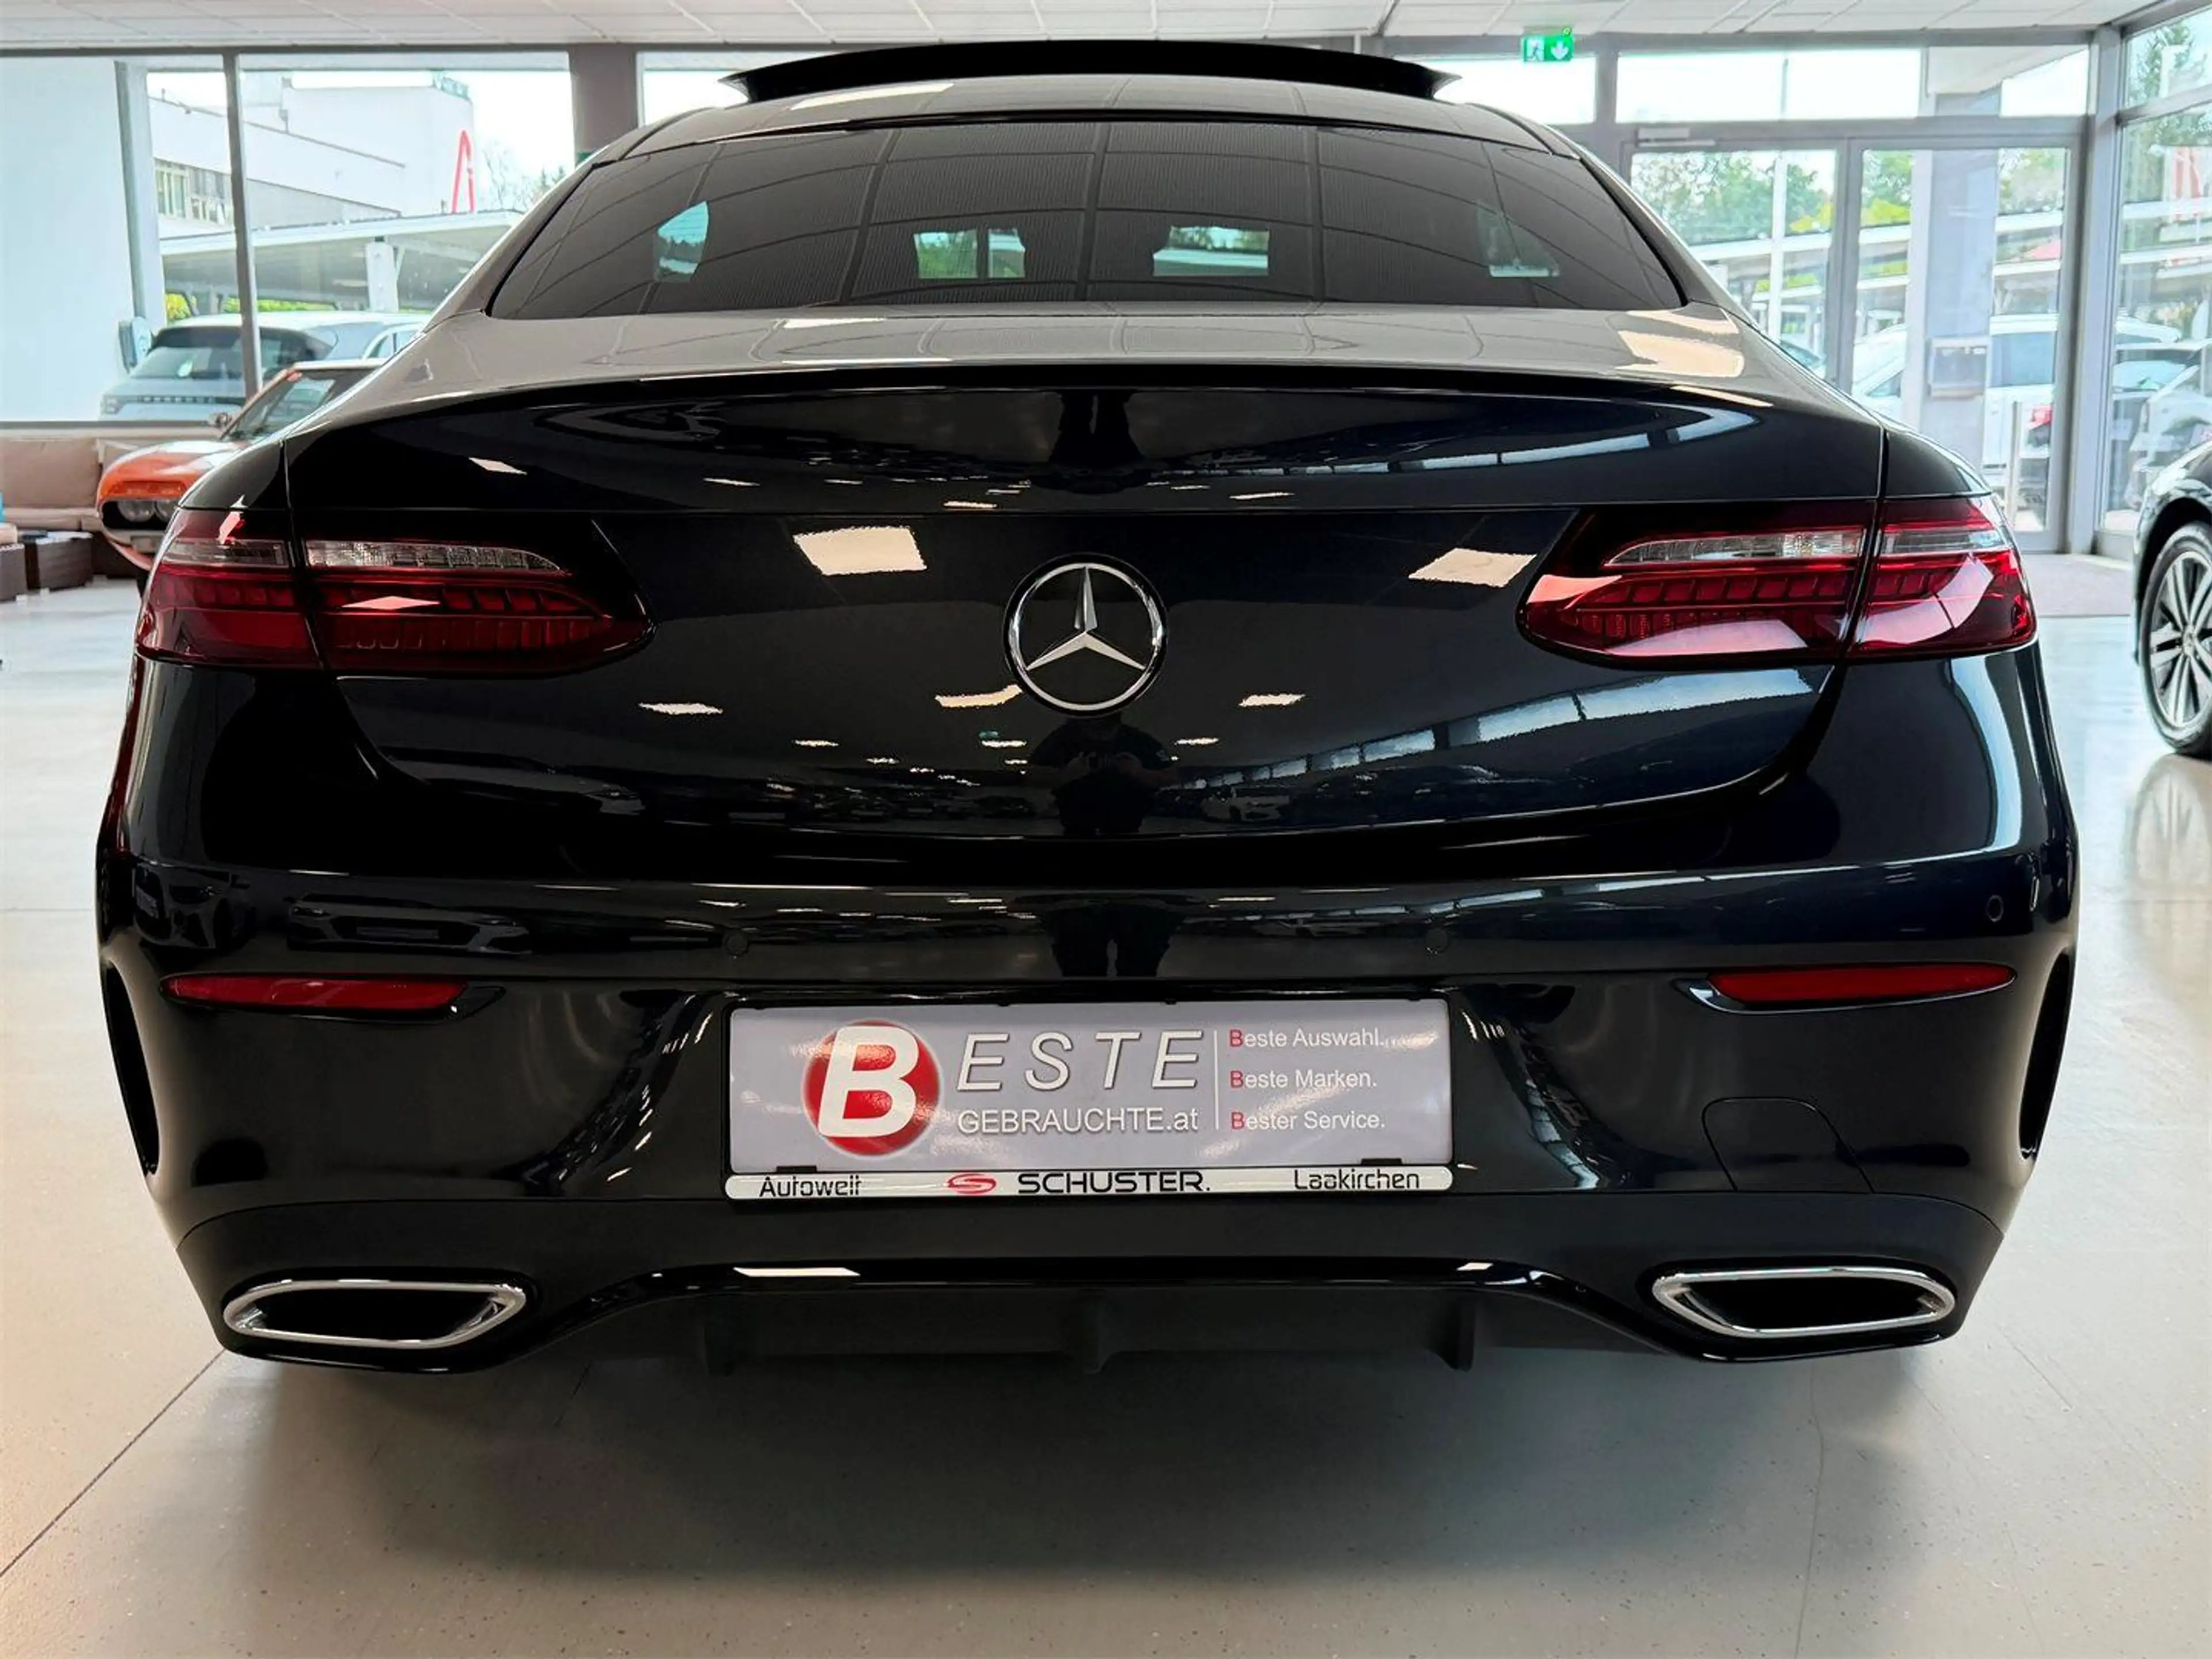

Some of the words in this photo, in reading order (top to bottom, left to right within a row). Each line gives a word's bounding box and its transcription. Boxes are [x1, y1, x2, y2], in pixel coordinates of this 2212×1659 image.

[1229, 1028, 1287, 1048] Beste
[1292, 1027, 1385, 1047] Auswahl.
[1230, 1070, 1289, 1089] Beste
[1296, 1069, 1377, 1088] Marken.
[957, 1107, 1200, 1134] GEBRAUCHTE.at
[1231, 1111, 1297, 1130] Bester
[1303, 1110, 1385, 1129] Service.
[1018, 1171, 1211, 1194] SCHUSTER.
[1294, 1168, 1419, 1190] Laakirchen
